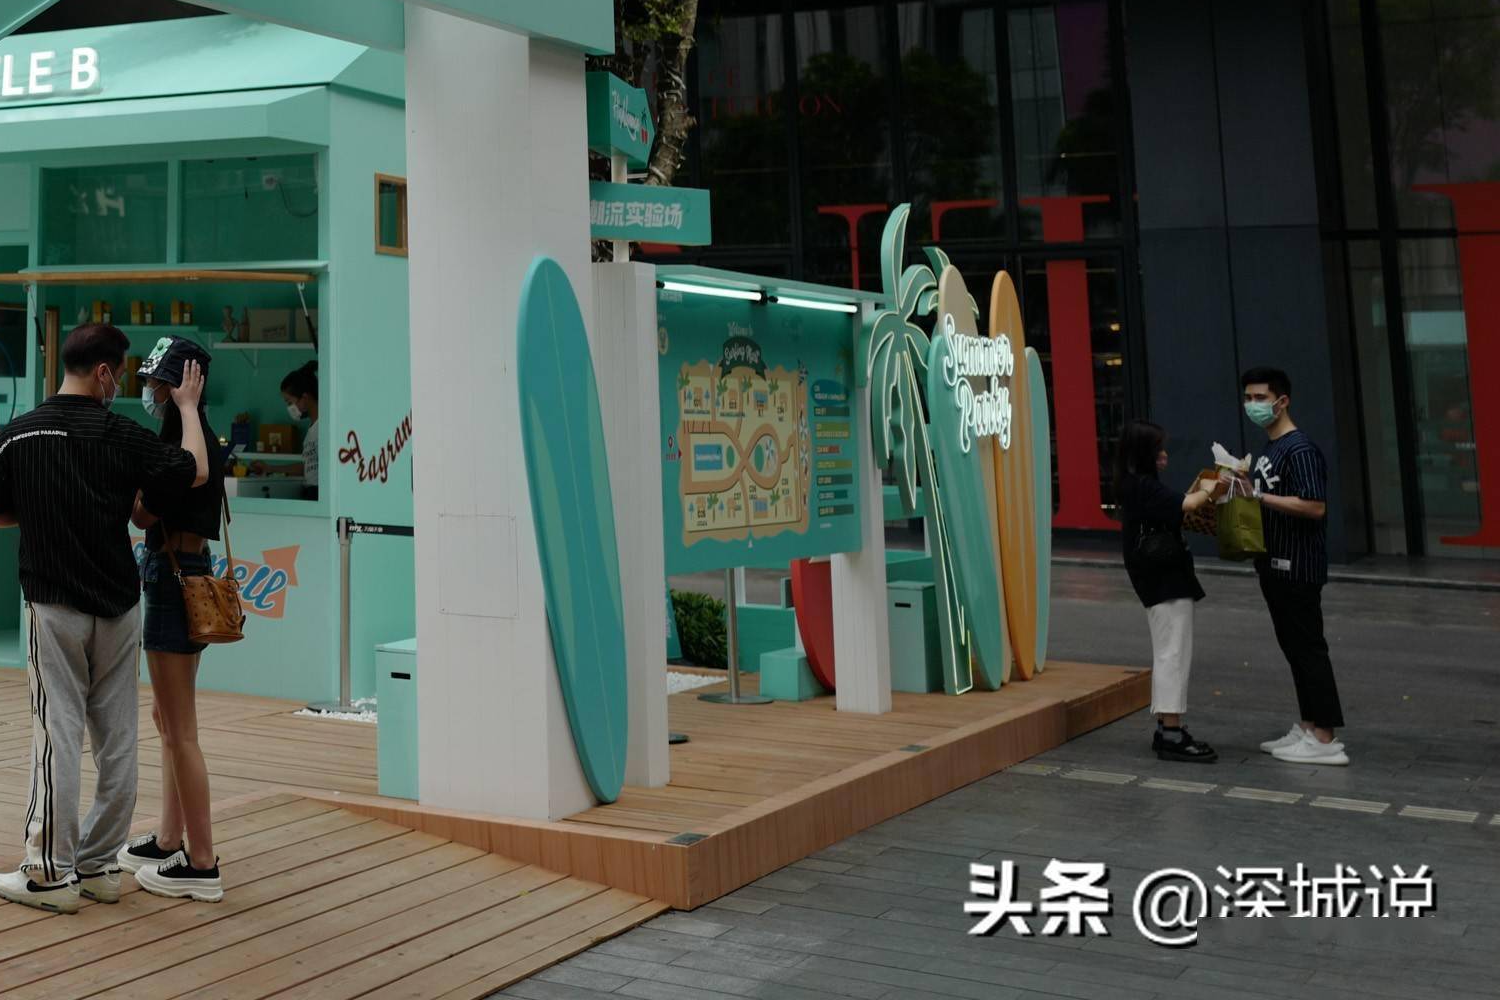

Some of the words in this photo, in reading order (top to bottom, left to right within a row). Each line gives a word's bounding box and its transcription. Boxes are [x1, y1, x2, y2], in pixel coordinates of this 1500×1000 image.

[71, 47, 100, 91] B
[943, 312, 1015, 387] Summer
[955, 376, 1012, 453] Party
